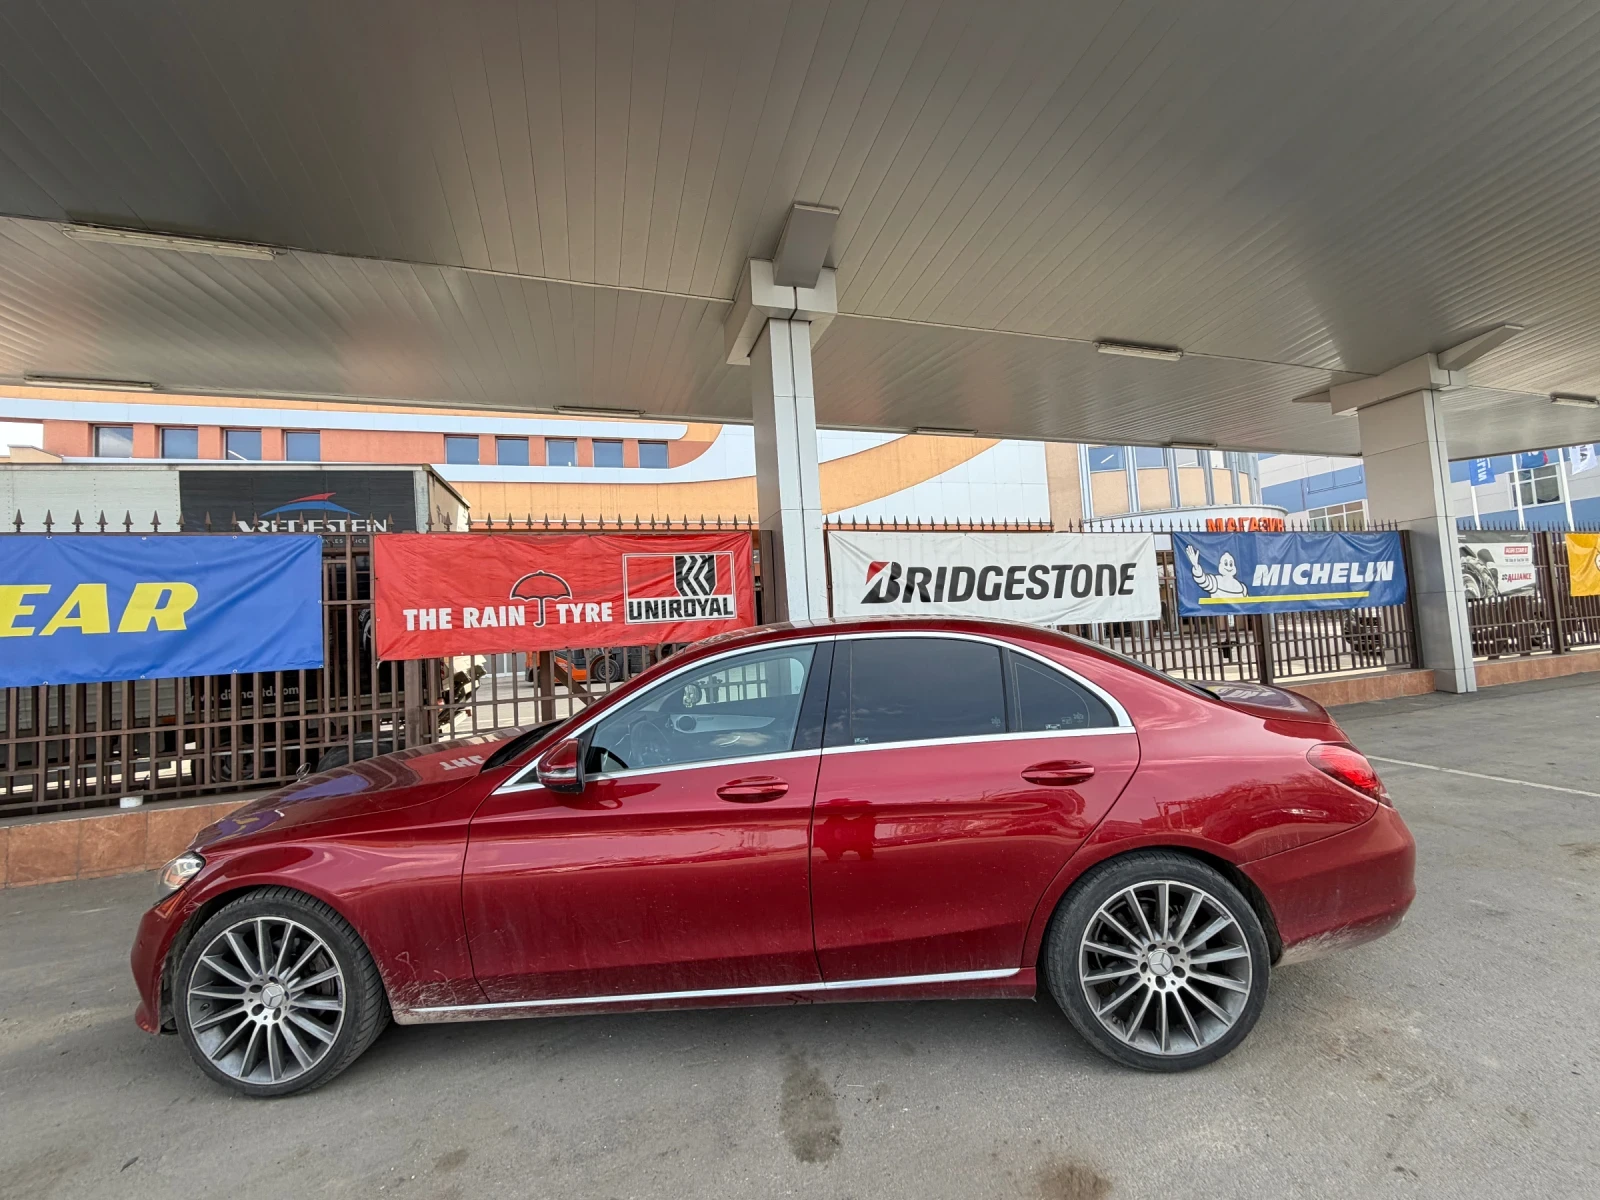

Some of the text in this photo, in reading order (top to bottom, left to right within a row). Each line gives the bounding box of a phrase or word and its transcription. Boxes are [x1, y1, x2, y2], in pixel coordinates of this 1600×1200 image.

[861, 561, 1137, 604] BRIDGESTONE
[1252, 561, 1394, 586] MICHELIN
[1507, 573, 1532, 582] ALLIANCE
[0, 581, 199, 637] EAR
[403, 602, 613, 631] THE RAIN TYRE
[628, 597, 734, 620] UNIROYAL
